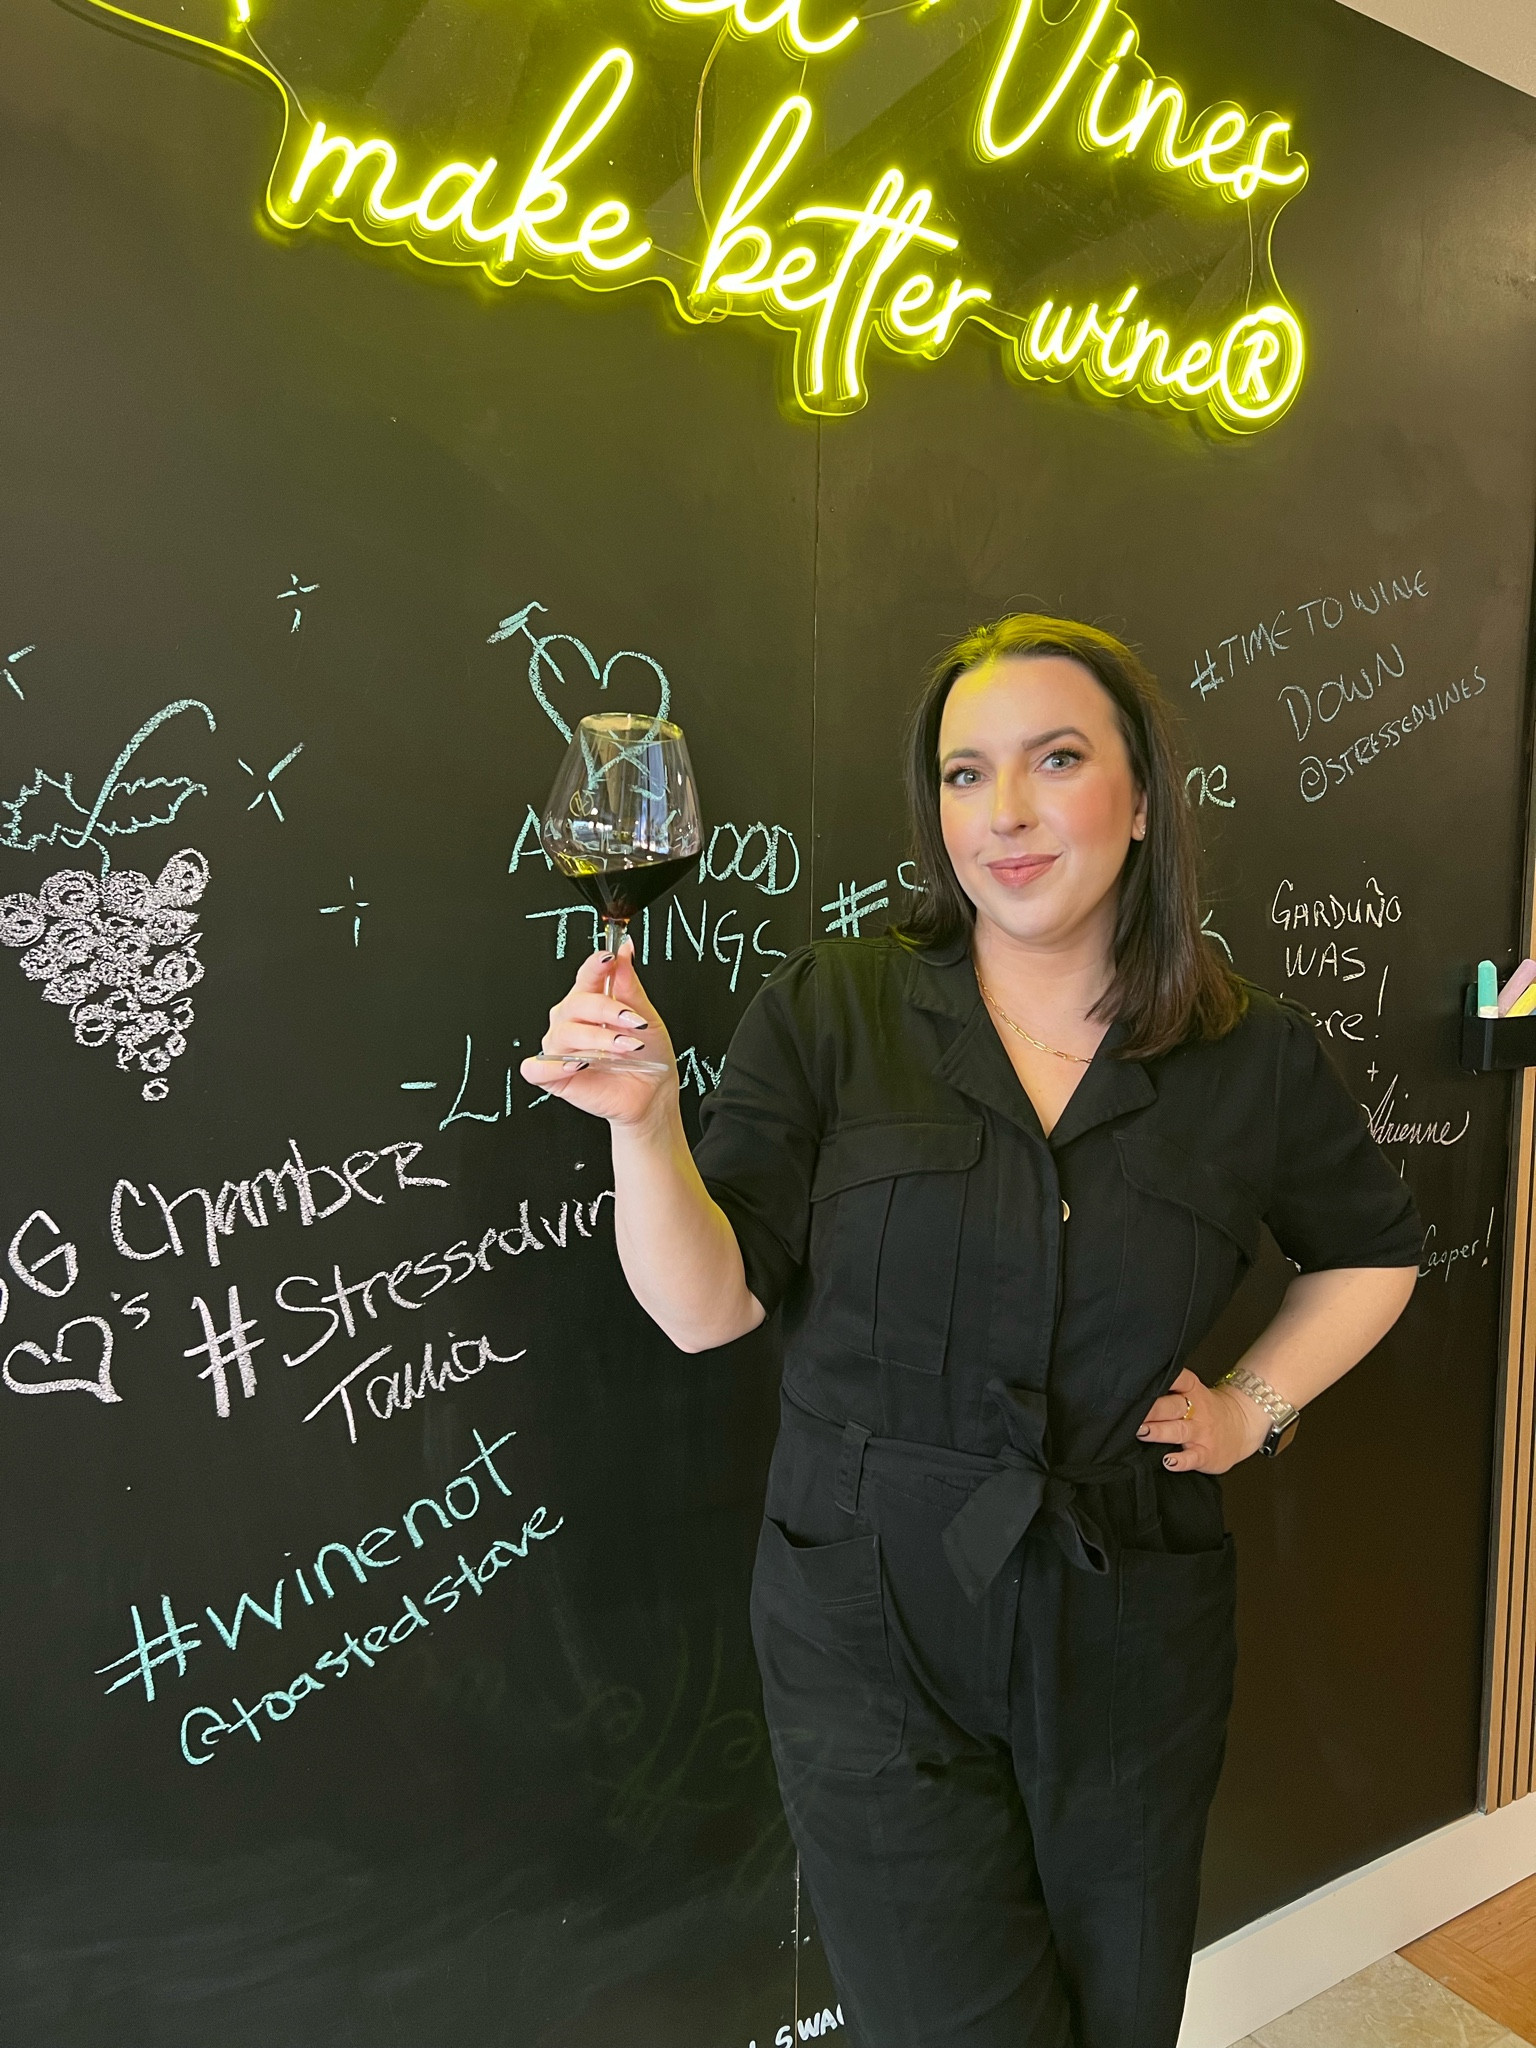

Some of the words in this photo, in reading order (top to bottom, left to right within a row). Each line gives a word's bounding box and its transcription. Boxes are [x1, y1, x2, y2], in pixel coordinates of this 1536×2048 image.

[972, 0, 1306, 201] Vines
[286, 46, 653, 272] make
[696, 94, 992, 400] better
[1276, 642, 1405, 741] DOWN
[1299, 665, 1487, 803] @STRESSEDVINES
[1285, 941, 1366, 982] WAS
[1360, 1073, 1470, 1146] Adrienne
[1417, 1206, 1496, 1283] Casper!
[95, 1428, 517, 1702] #winenot
[179, 1505, 565, 1766] @toastedstave
